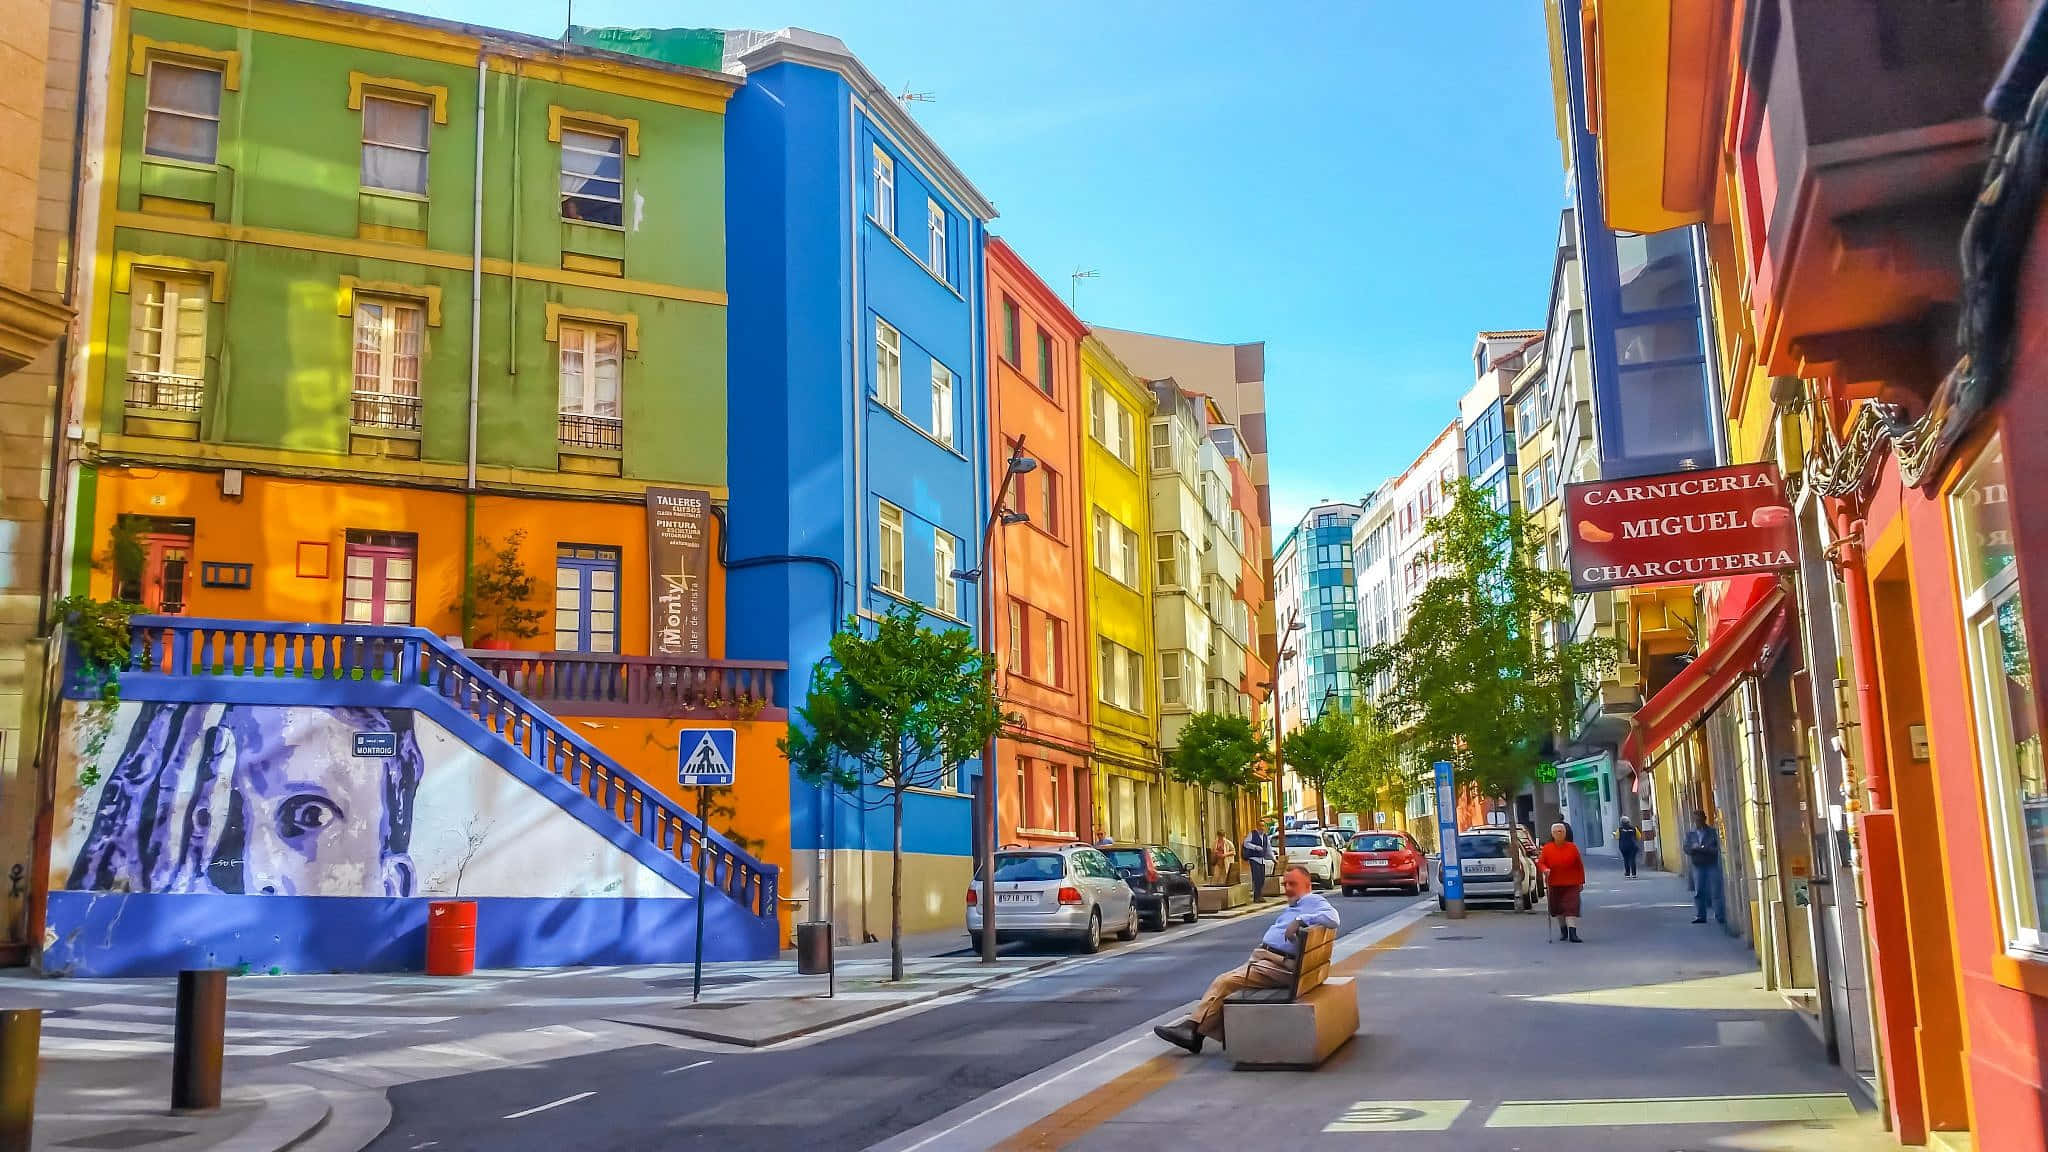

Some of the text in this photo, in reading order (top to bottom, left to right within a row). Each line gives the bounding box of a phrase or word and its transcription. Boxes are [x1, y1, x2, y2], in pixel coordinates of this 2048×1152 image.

[1583, 473, 1776, 506] CARNICERIA
[656, 495, 702, 508] TALLERES
[656, 519, 697, 530] PINTURA
[1621, 510, 1748, 540] MIGUEL
[1582, 550, 1795, 582] CHARCUTERIA
[690, 614, 699, 626] de
[690, 630, 699, 653] taller
